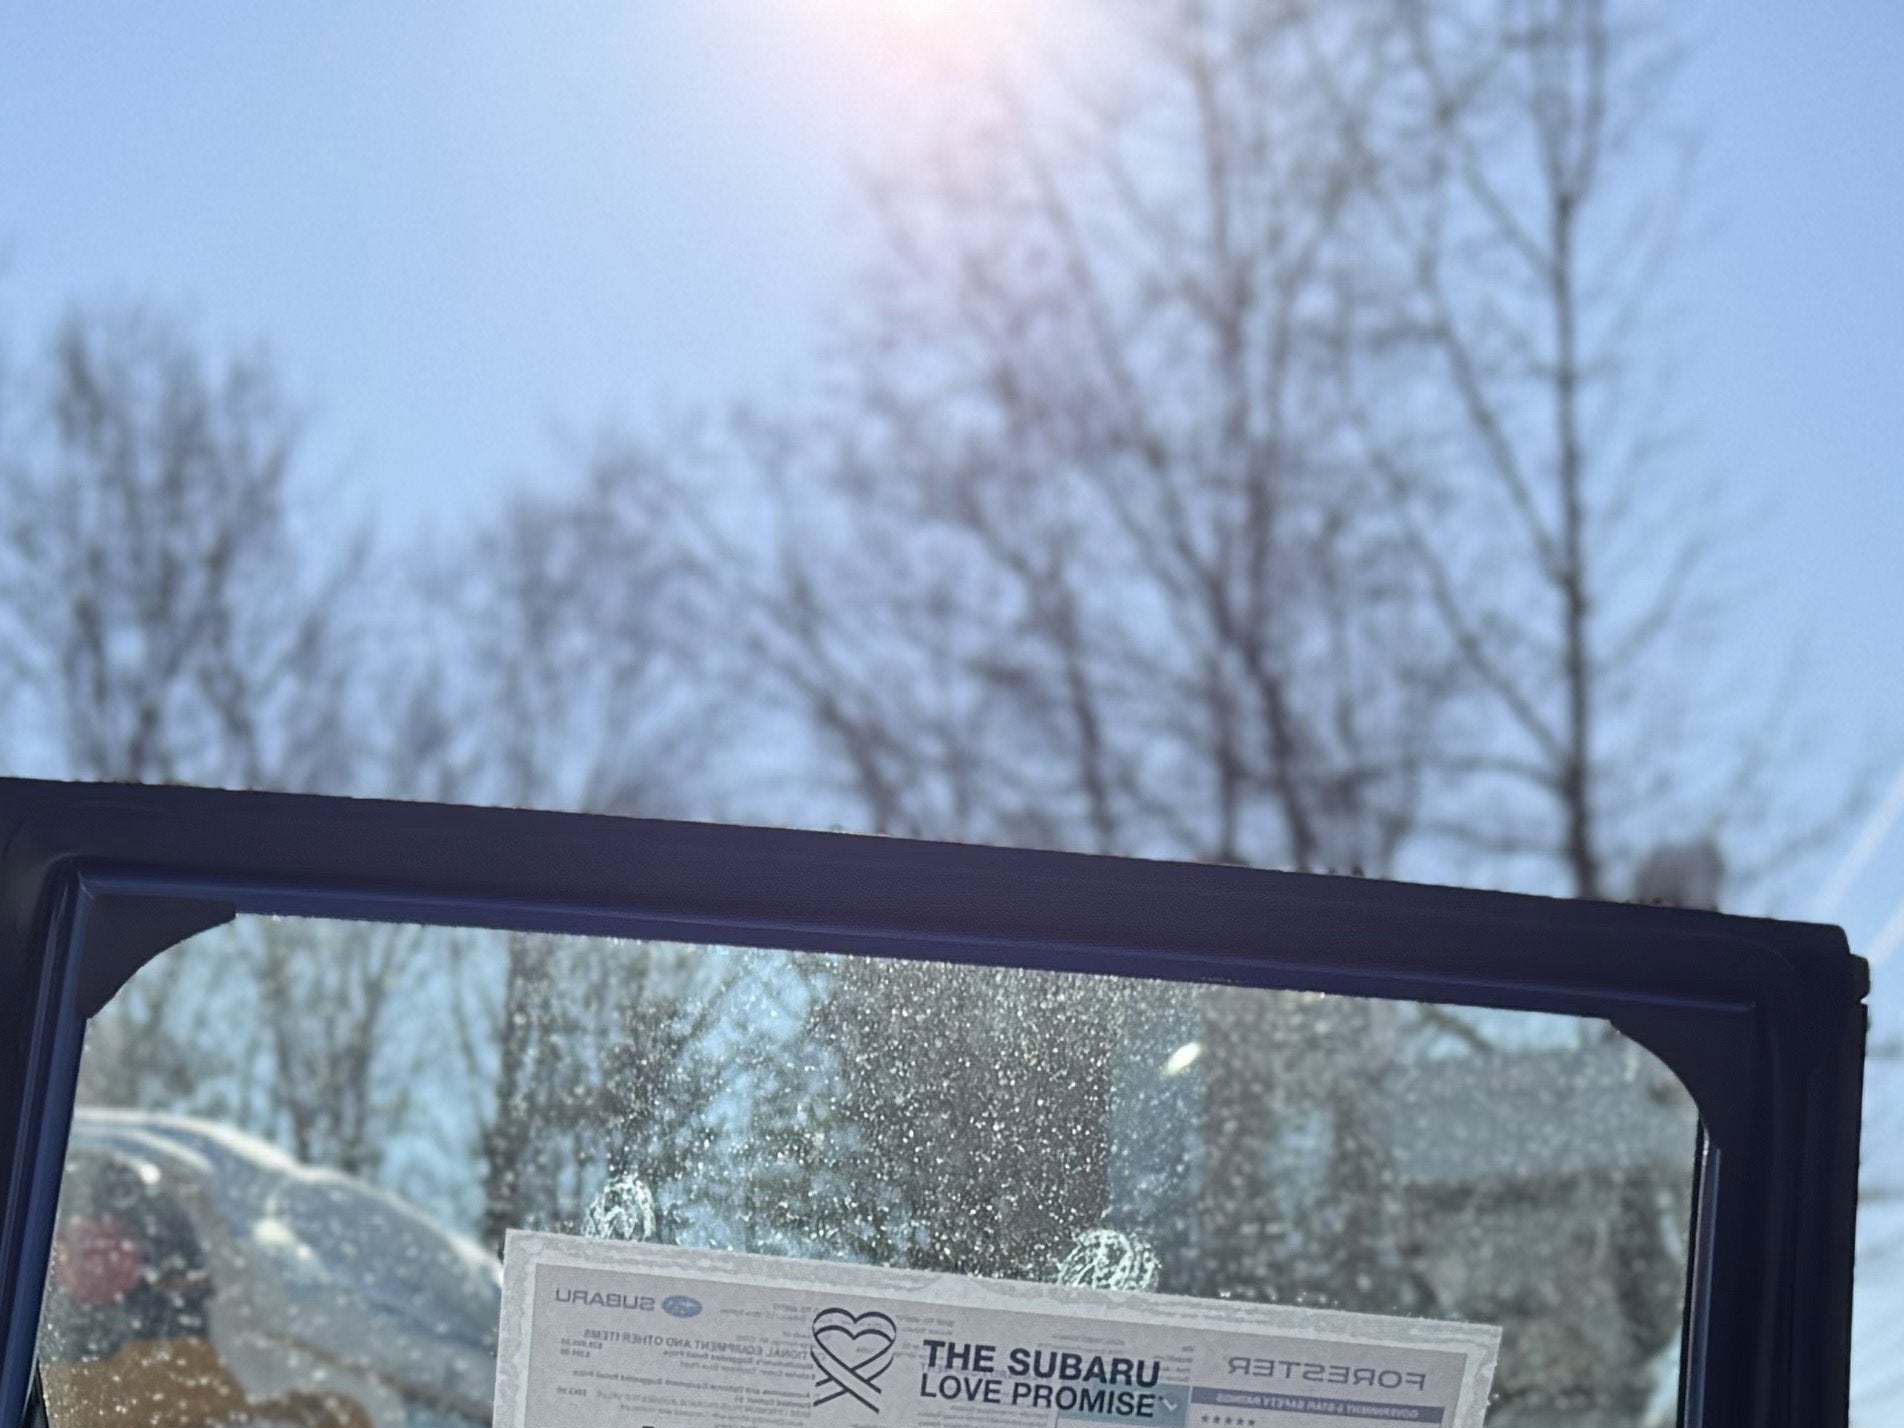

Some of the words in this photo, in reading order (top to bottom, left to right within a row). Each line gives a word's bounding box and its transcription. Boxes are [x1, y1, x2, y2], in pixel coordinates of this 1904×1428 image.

[923, 1339, 996, 1373] THE
[1007, 1347, 1161, 1388] SUBARU
[920, 1372, 1002, 1404] LOVE
[1011, 1381, 1157, 1418] PROMISE
